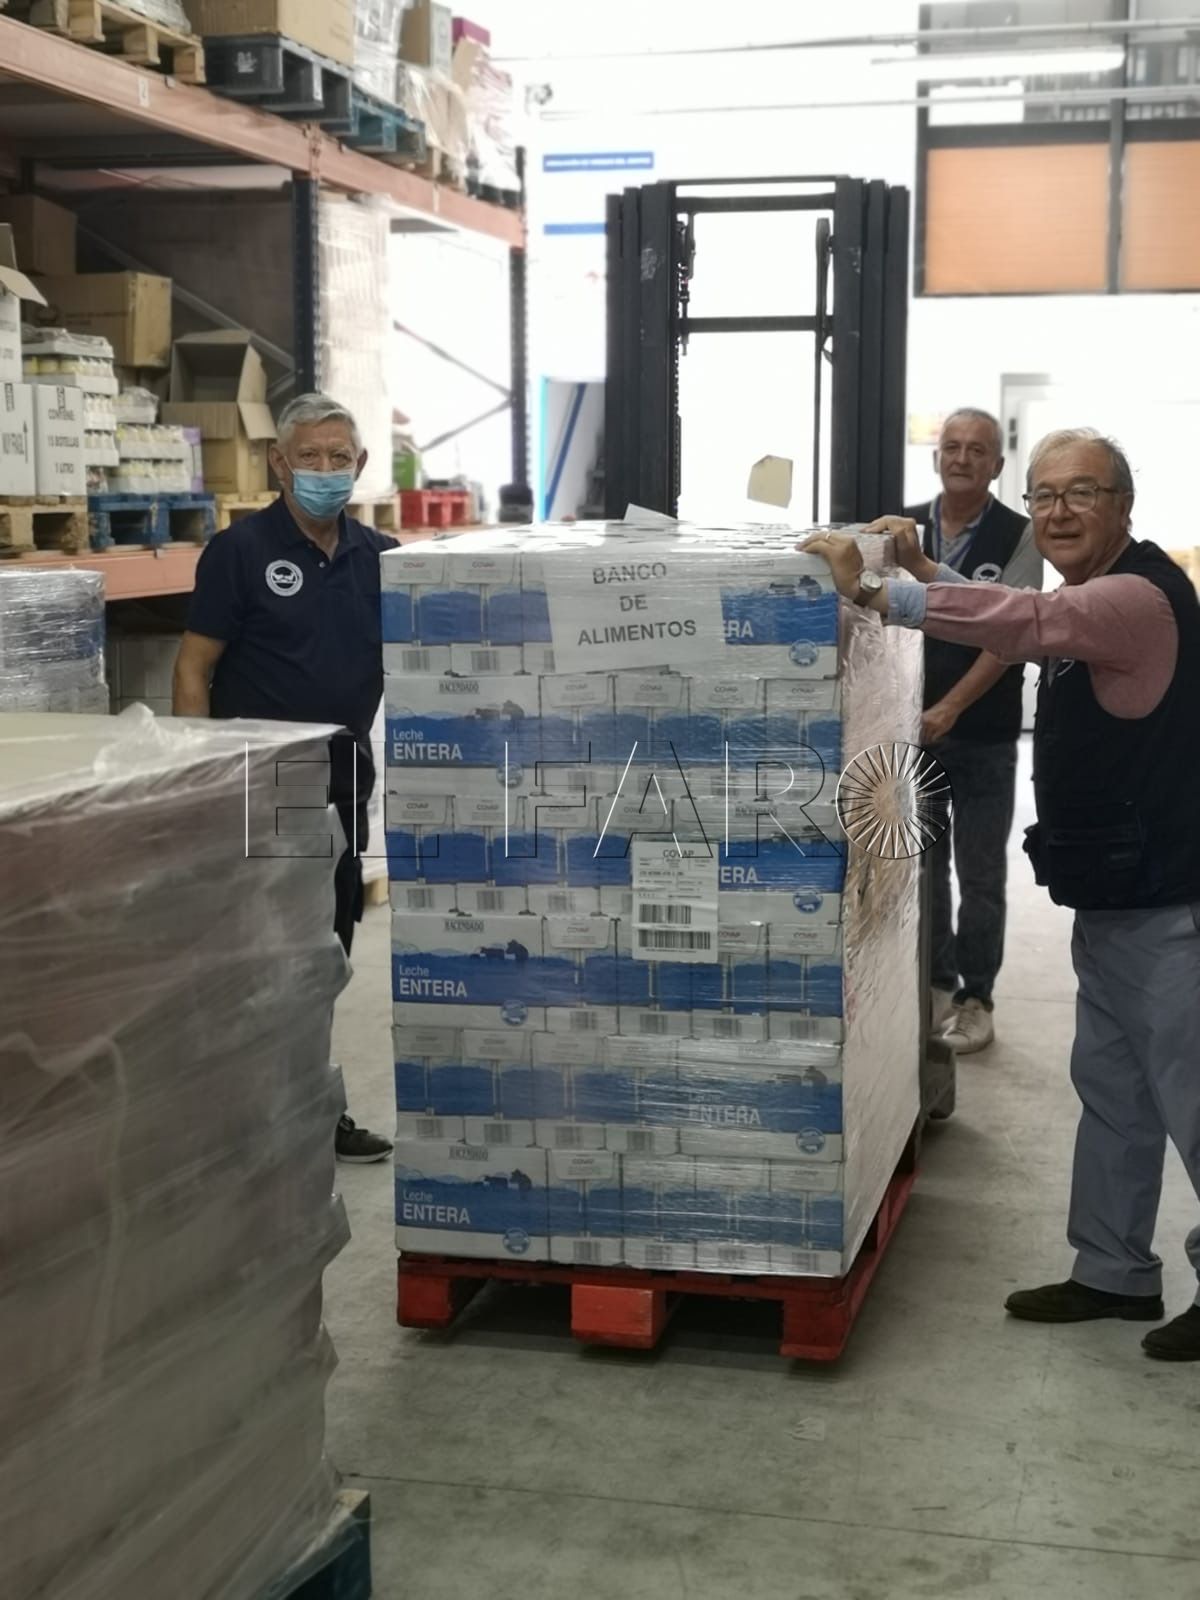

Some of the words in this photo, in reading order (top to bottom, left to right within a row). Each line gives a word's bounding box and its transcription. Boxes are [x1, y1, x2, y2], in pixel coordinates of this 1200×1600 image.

[592, 561, 667, 585] BANCO
[619, 594, 648, 613] DE
[577, 619, 698, 647] ALIMENTOS
[392, 728, 424, 741] Leche
[392, 743, 463, 760] ENTERA
[663, 849, 695, 858] COVAP
[399, 965, 430, 977] Leche
[399, 978, 468, 998] ENTERA
[689, 1105, 762, 1125] ENTERA
[403, 1189, 433, 1202] Leche
[403, 1203, 471, 1224] ENTERA
